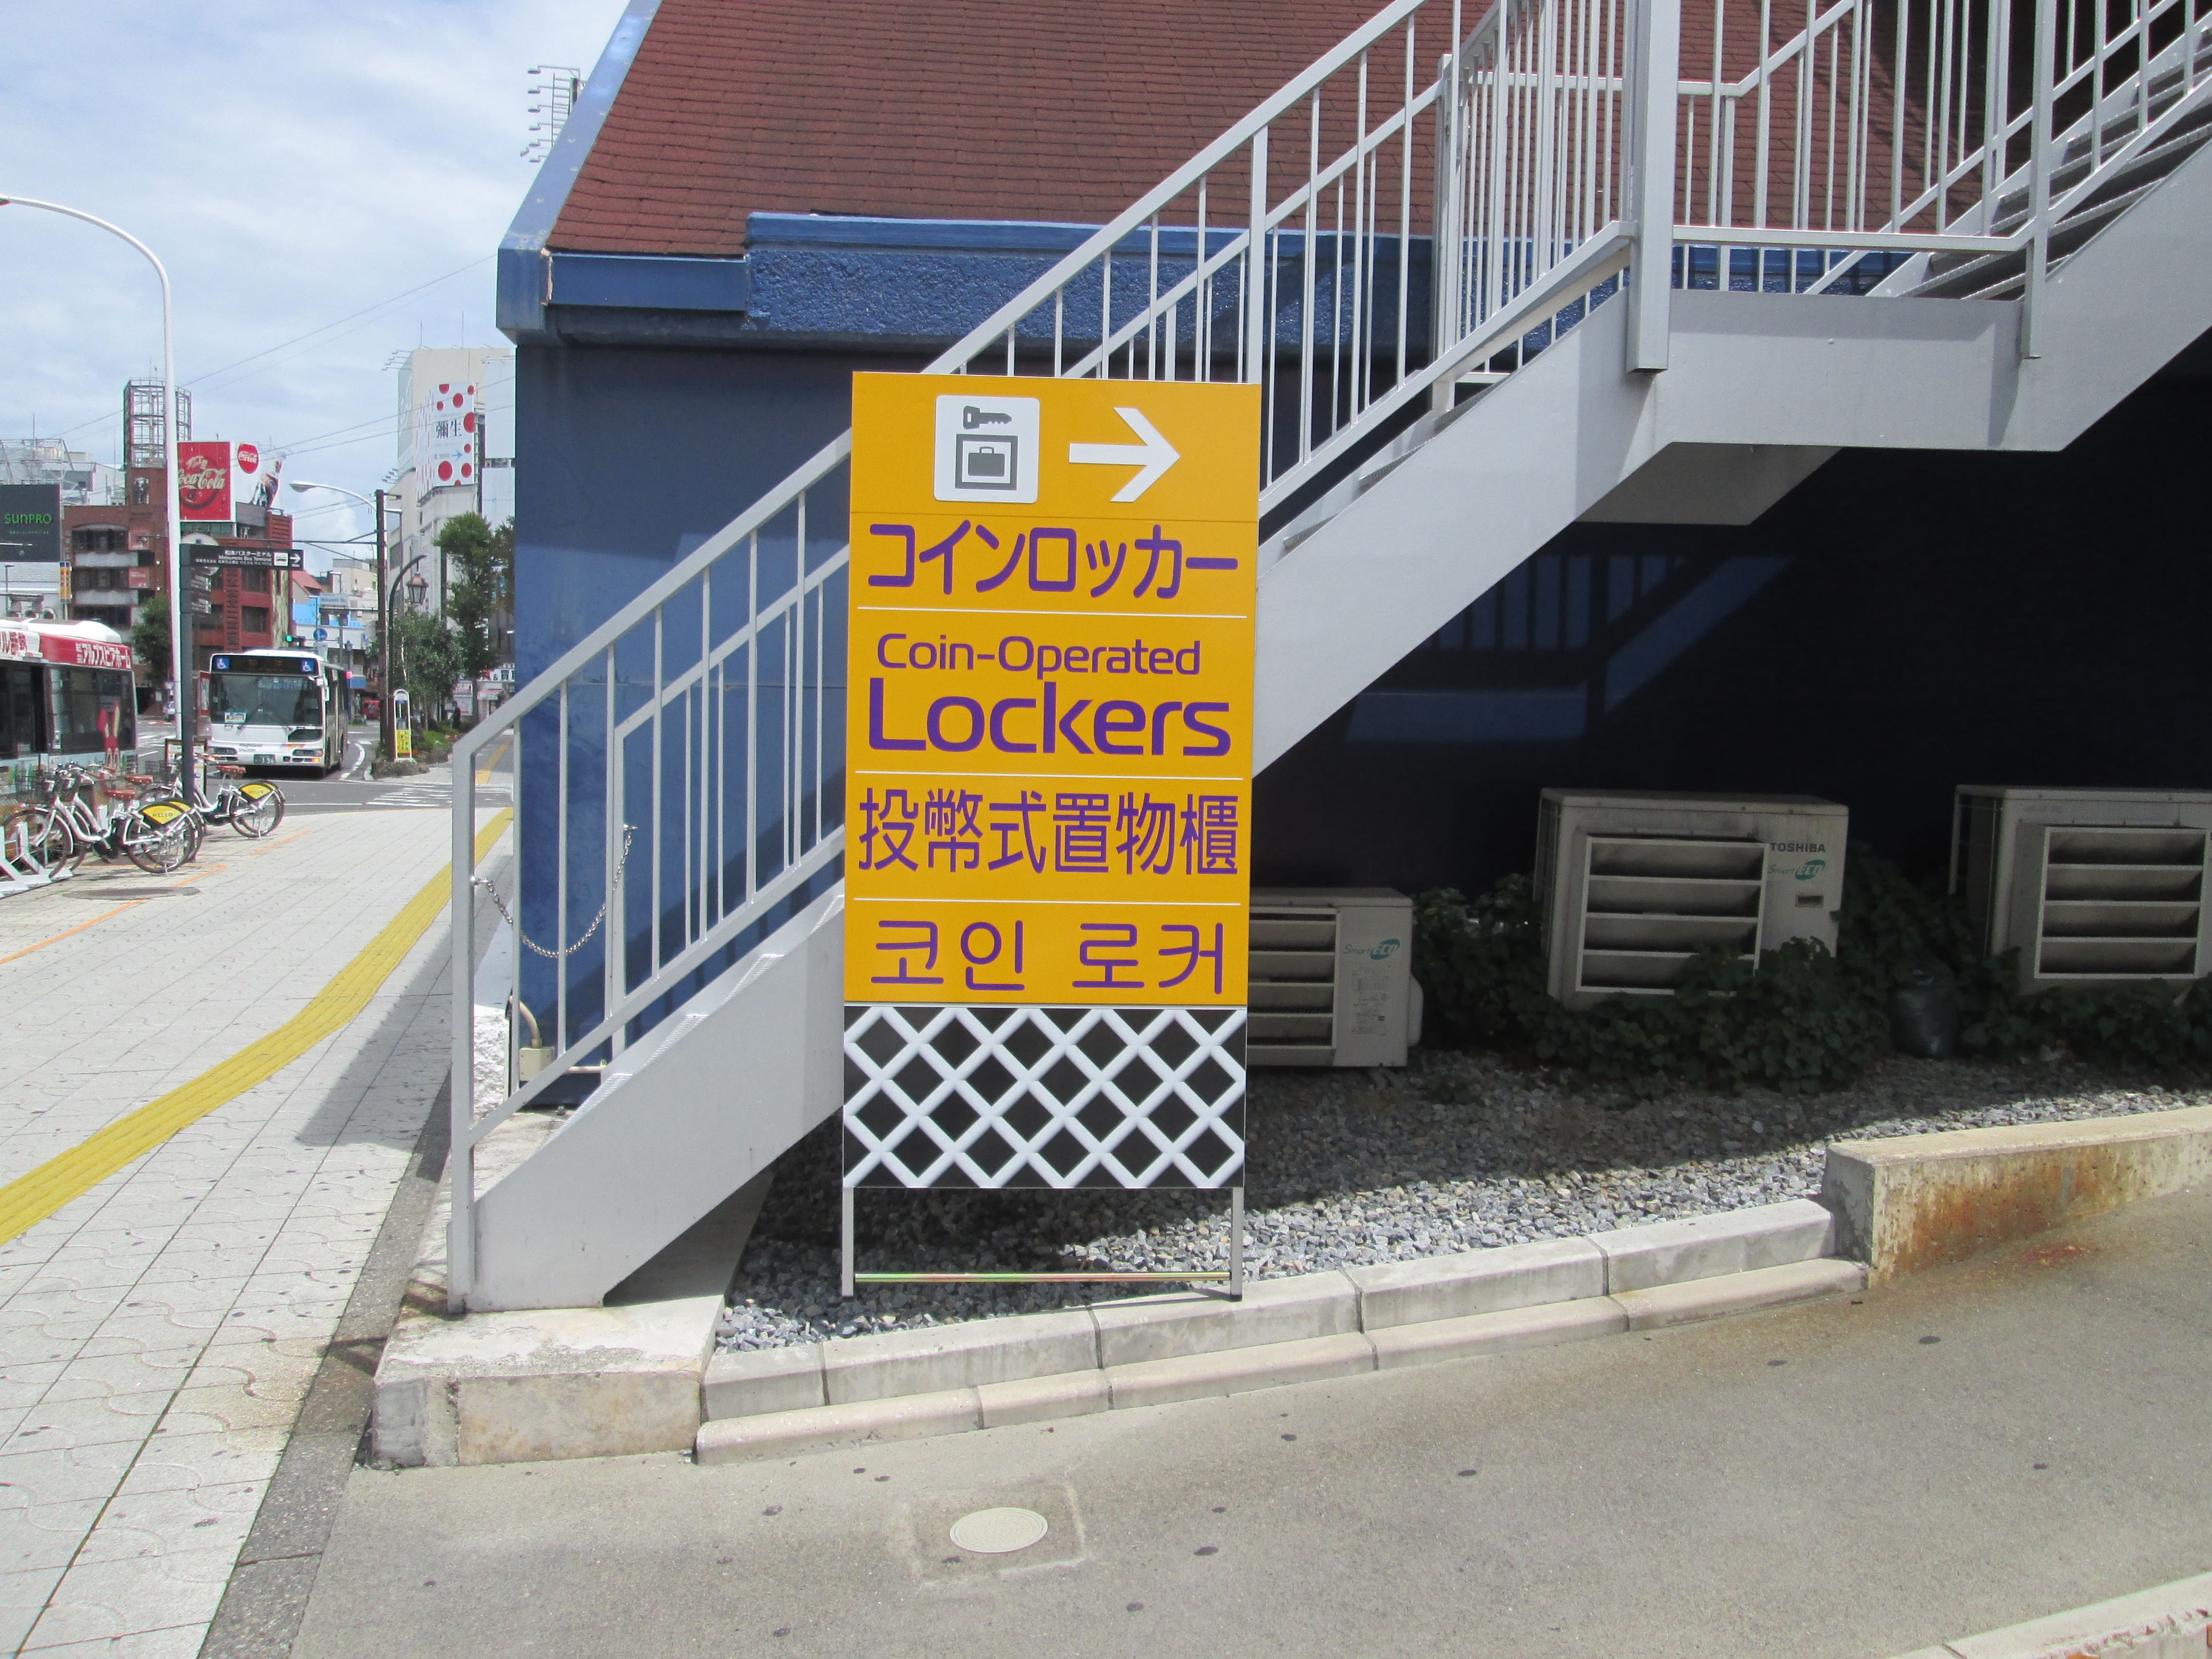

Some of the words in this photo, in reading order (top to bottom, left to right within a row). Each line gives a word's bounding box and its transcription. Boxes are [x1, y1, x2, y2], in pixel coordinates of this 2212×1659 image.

[239, 451, 257, 464] Coca-Cola
[869, 521, 1238, 598] コインロッカー
[878, 634, 1200, 679] Coin-Operated
[869, 677, 1230, 756] Lockers
[859, 789, 1238, 874] 投幣式置物櫃
[1769, 842, 1826, 853] TOSHIBA
[871, 920, 1025, 991] 코인
[1072, 923, 1223, 994] 로커
